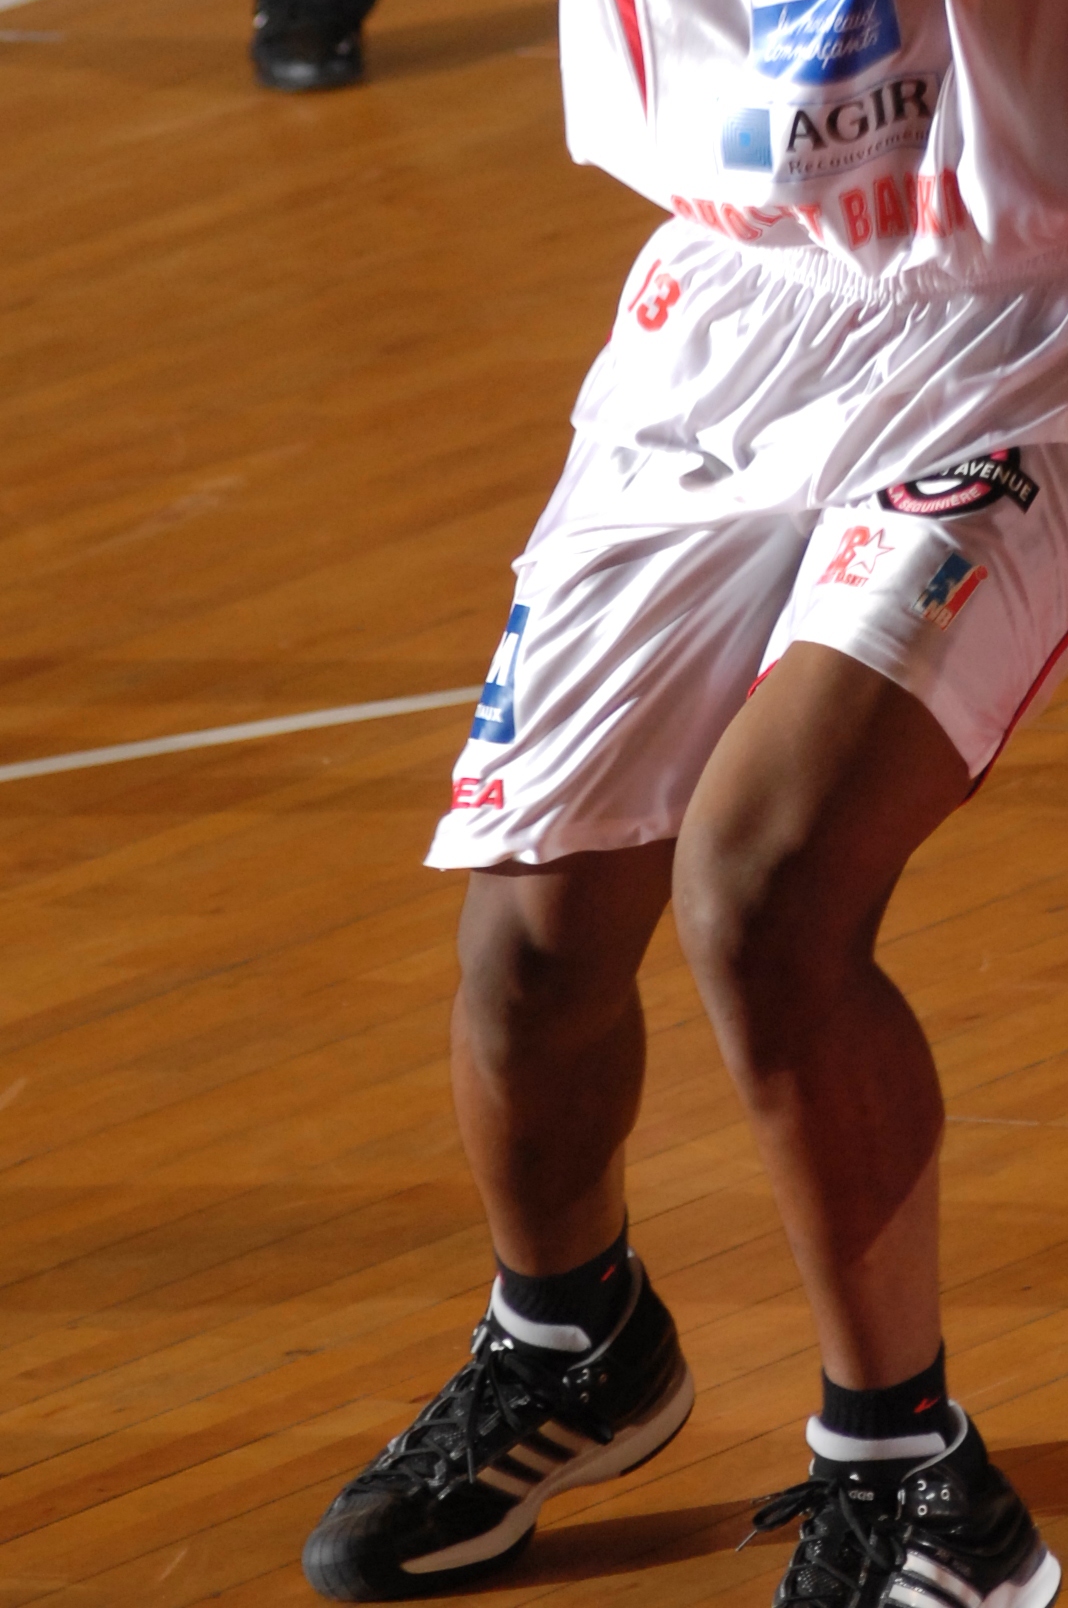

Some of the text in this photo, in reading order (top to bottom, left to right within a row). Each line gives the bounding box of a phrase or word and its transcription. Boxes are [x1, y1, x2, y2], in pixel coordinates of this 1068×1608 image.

[786, 77, 932, 154] AGIR
[787, 128, 926, 176] Recouvremen
[954, 459, 1032, 502] AVENUE
